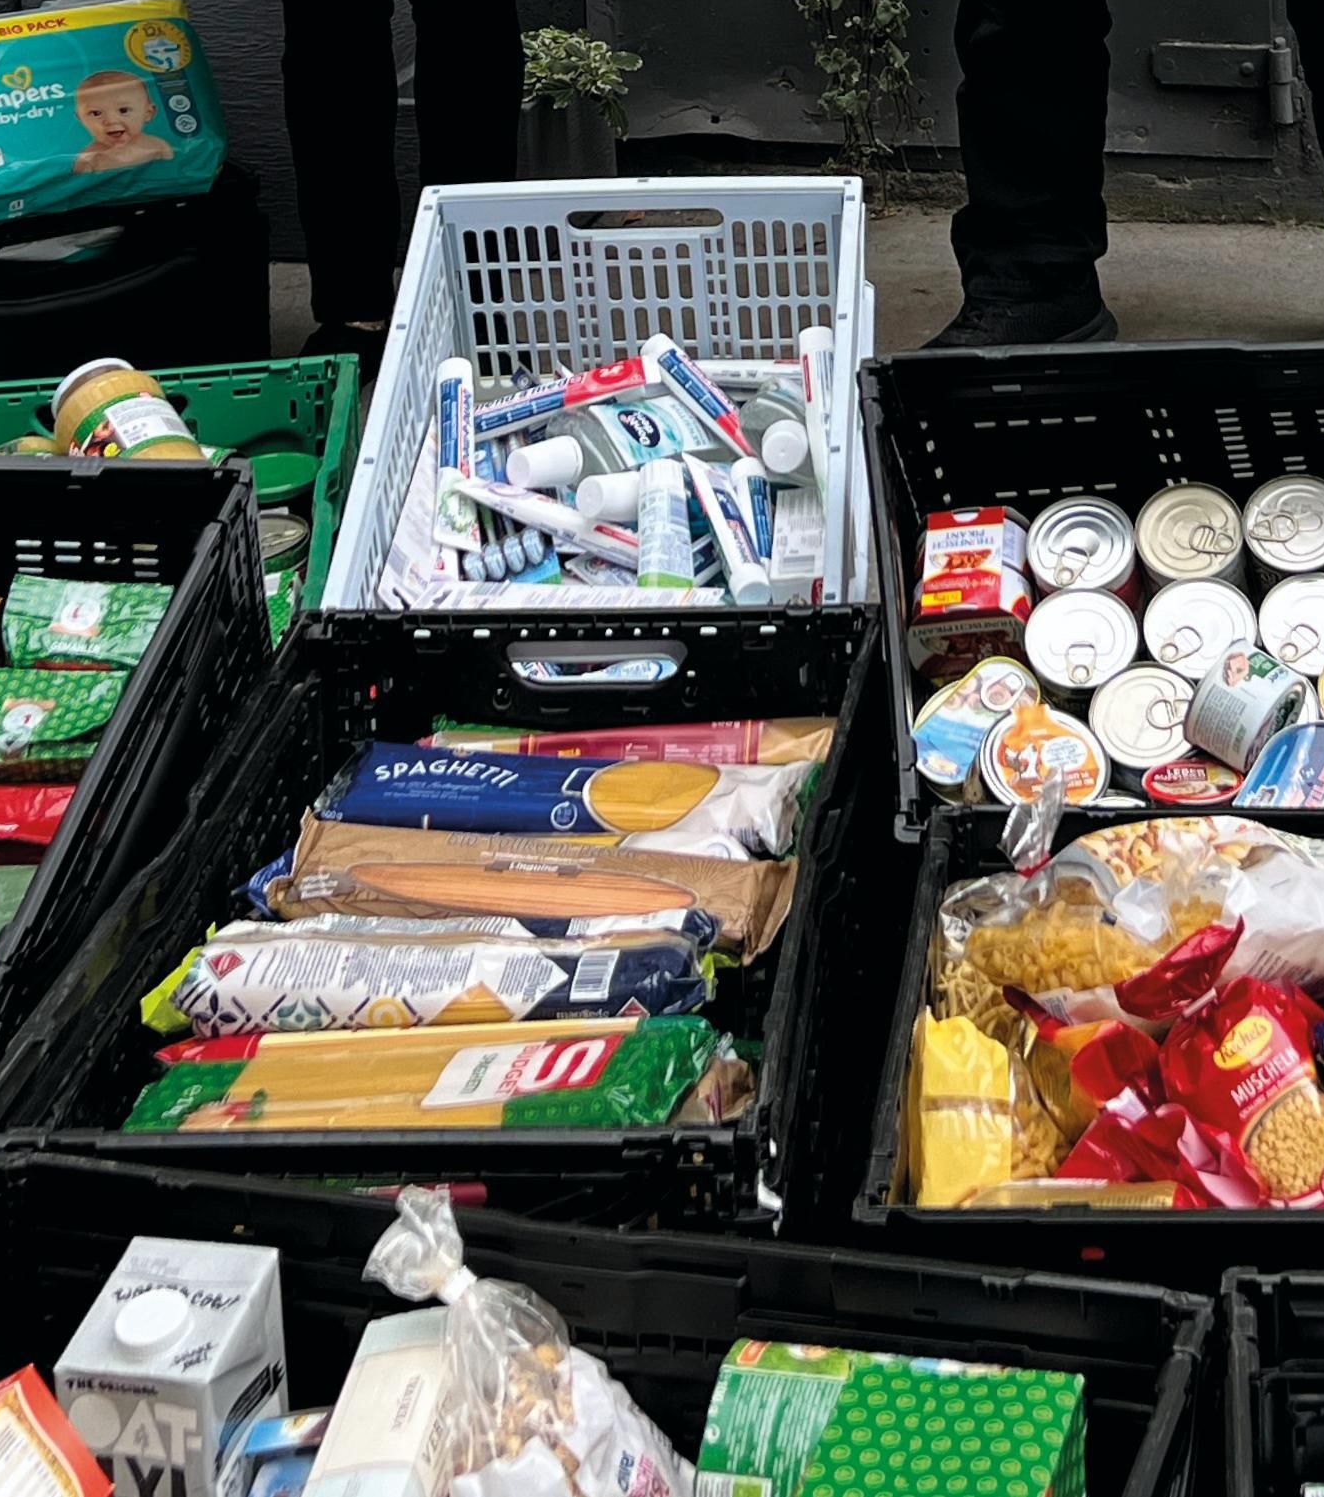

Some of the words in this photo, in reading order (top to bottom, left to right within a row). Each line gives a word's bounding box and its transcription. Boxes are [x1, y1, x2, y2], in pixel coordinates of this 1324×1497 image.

[26, 17, 67, 34] PACK
[374, 759, 520, 789] SPAGHETTI
[496, 1042, 544, 1096] BUDGET
[1229, 1045, 1302, 1108] MUSCHELN
[65, 1378, 94, 1389] THE
